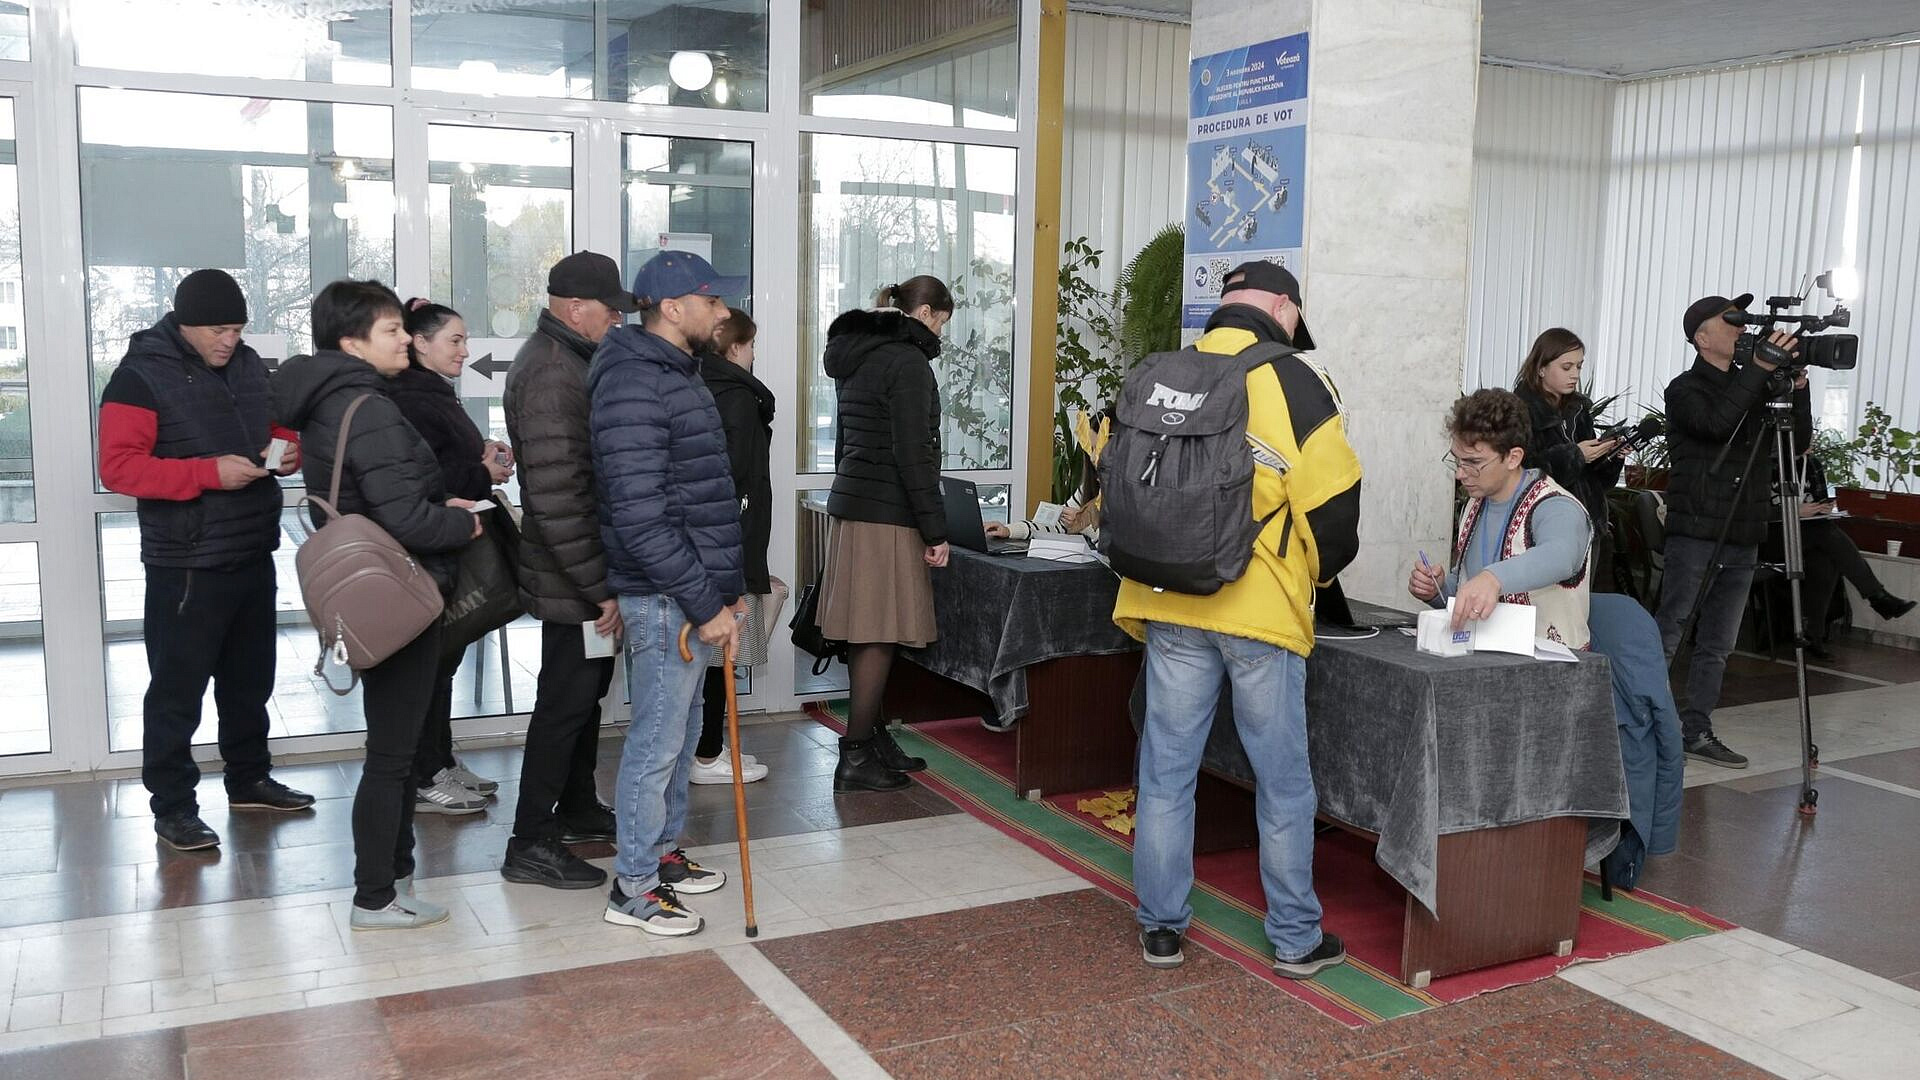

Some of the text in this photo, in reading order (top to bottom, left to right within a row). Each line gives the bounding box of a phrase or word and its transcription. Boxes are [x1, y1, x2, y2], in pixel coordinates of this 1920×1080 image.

[1251, 61, 1265, 72] 2024
[1197, 108, 1293, 135] PROCEDURA DE VOT
